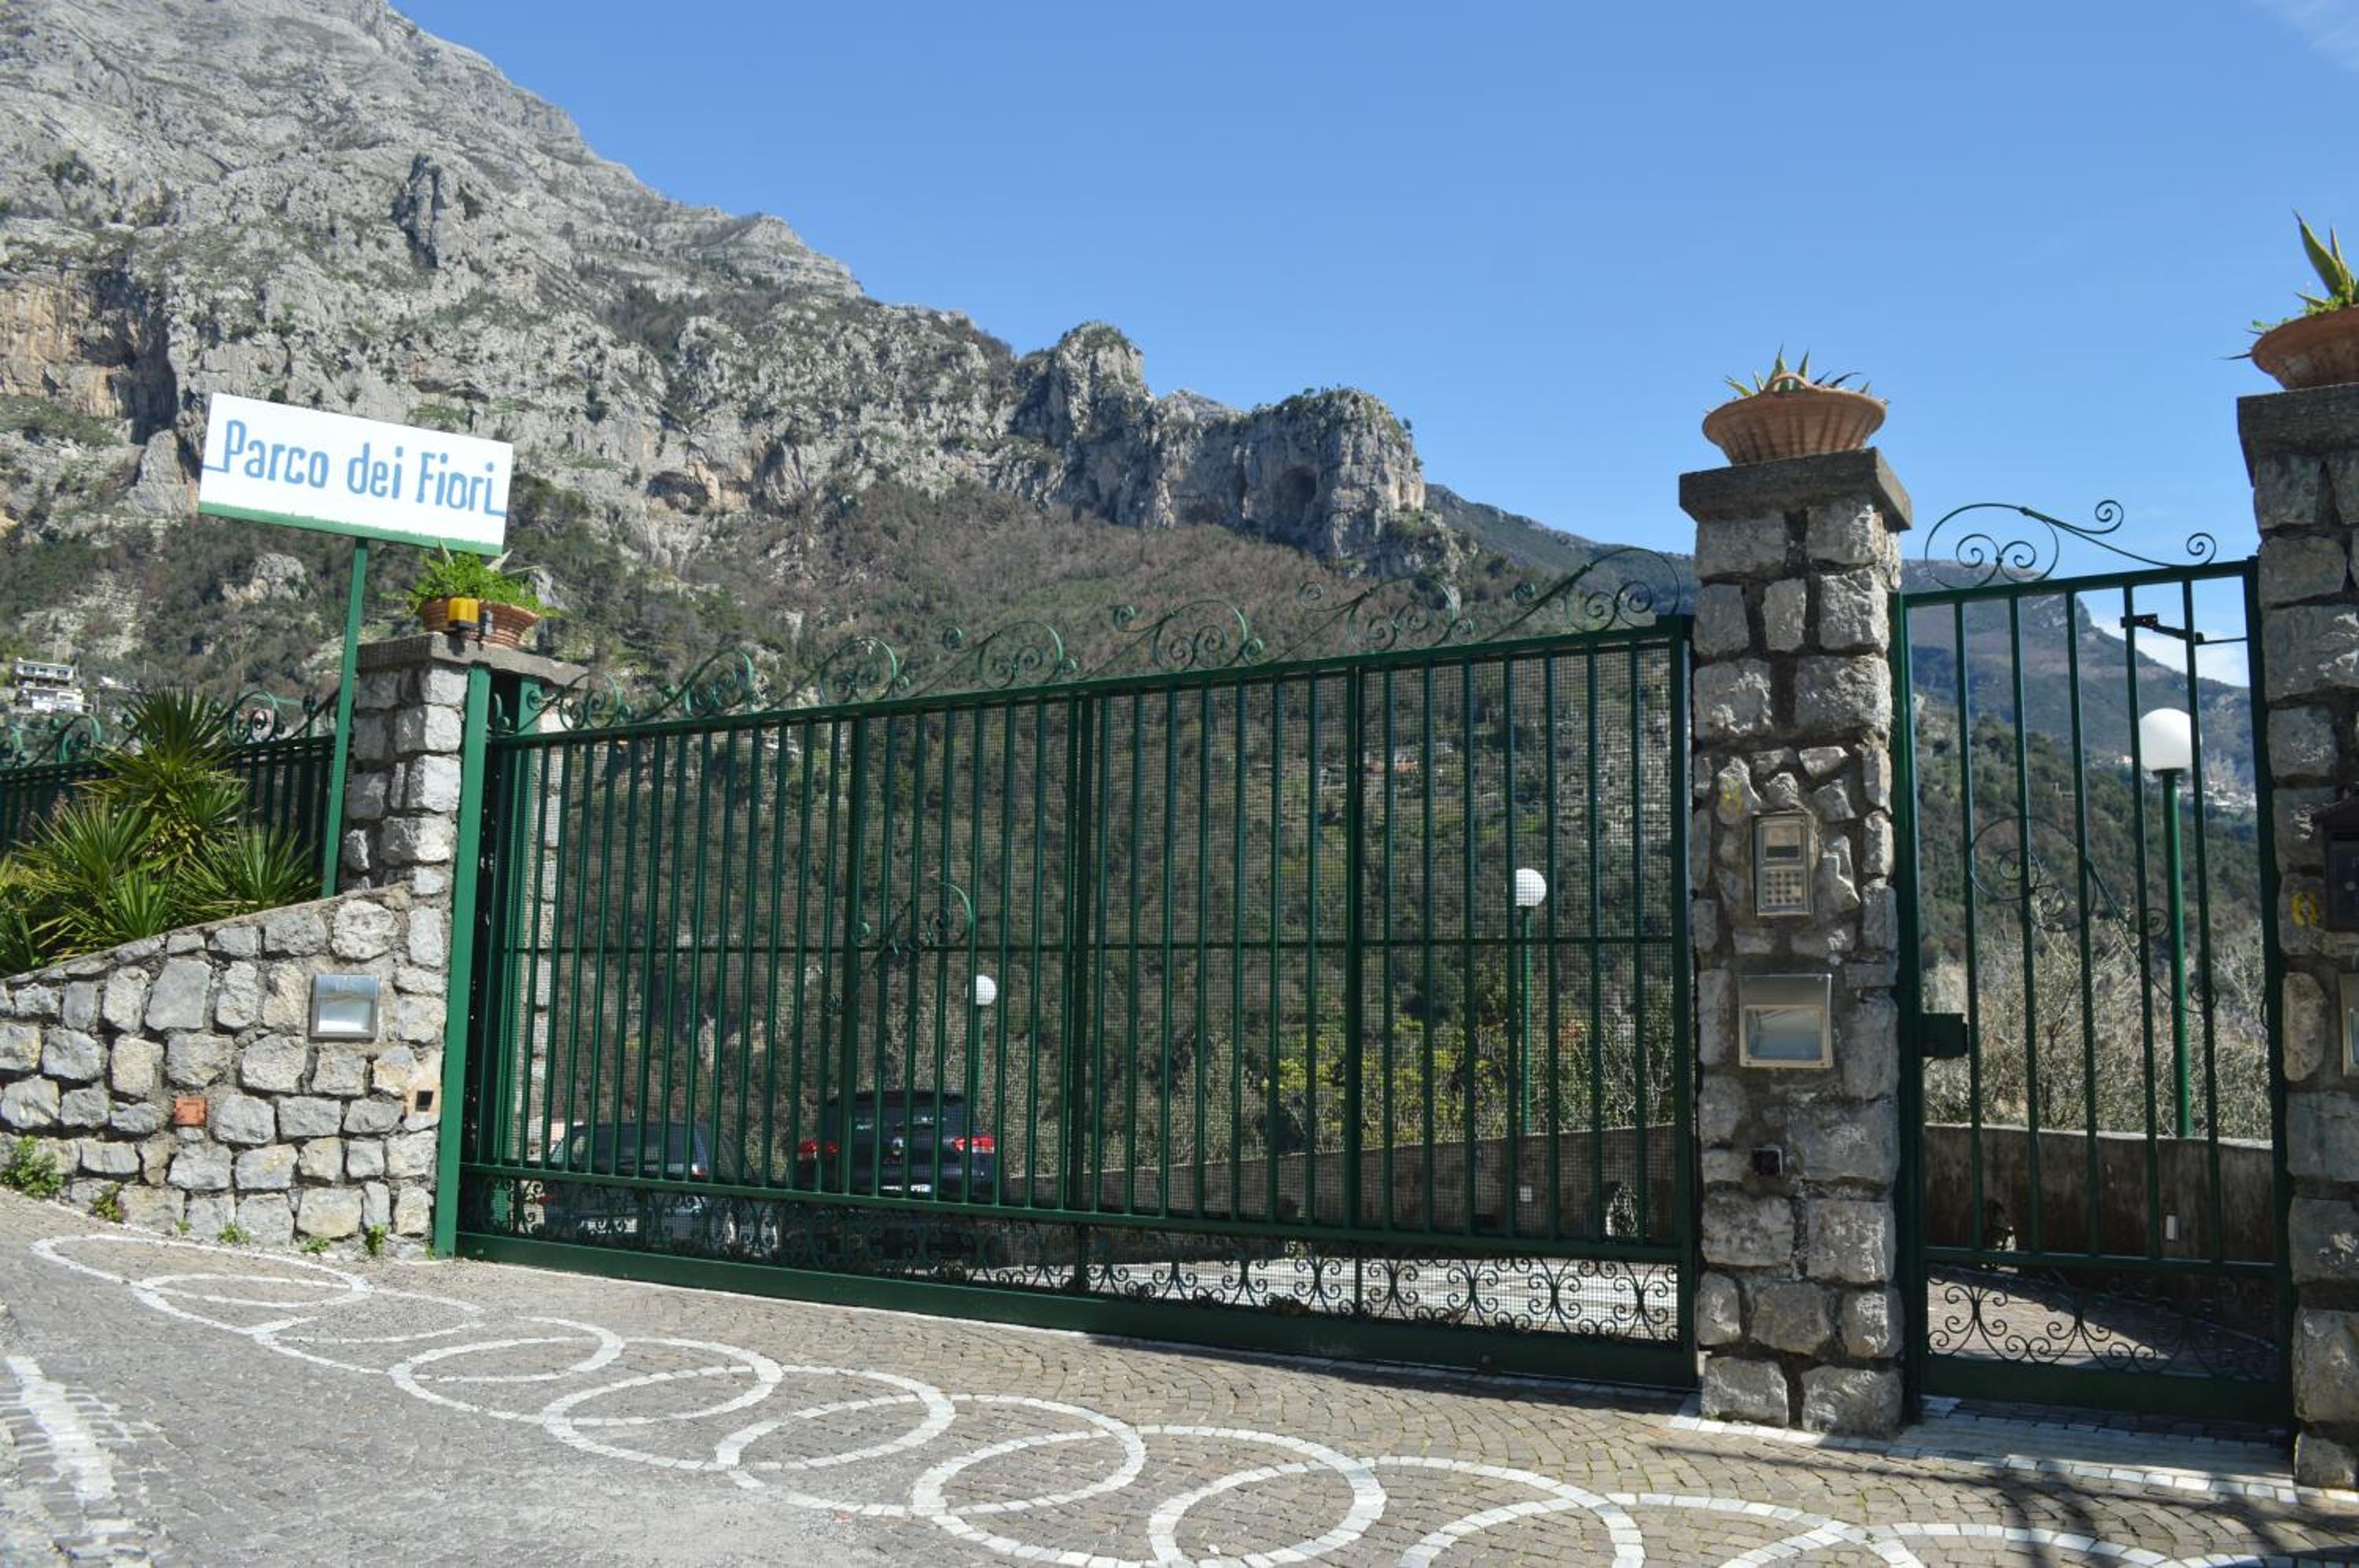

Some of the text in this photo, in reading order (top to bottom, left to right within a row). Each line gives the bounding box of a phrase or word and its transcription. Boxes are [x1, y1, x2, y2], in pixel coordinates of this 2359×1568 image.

[202, 419, 506, 517] Parco dei Fiori
